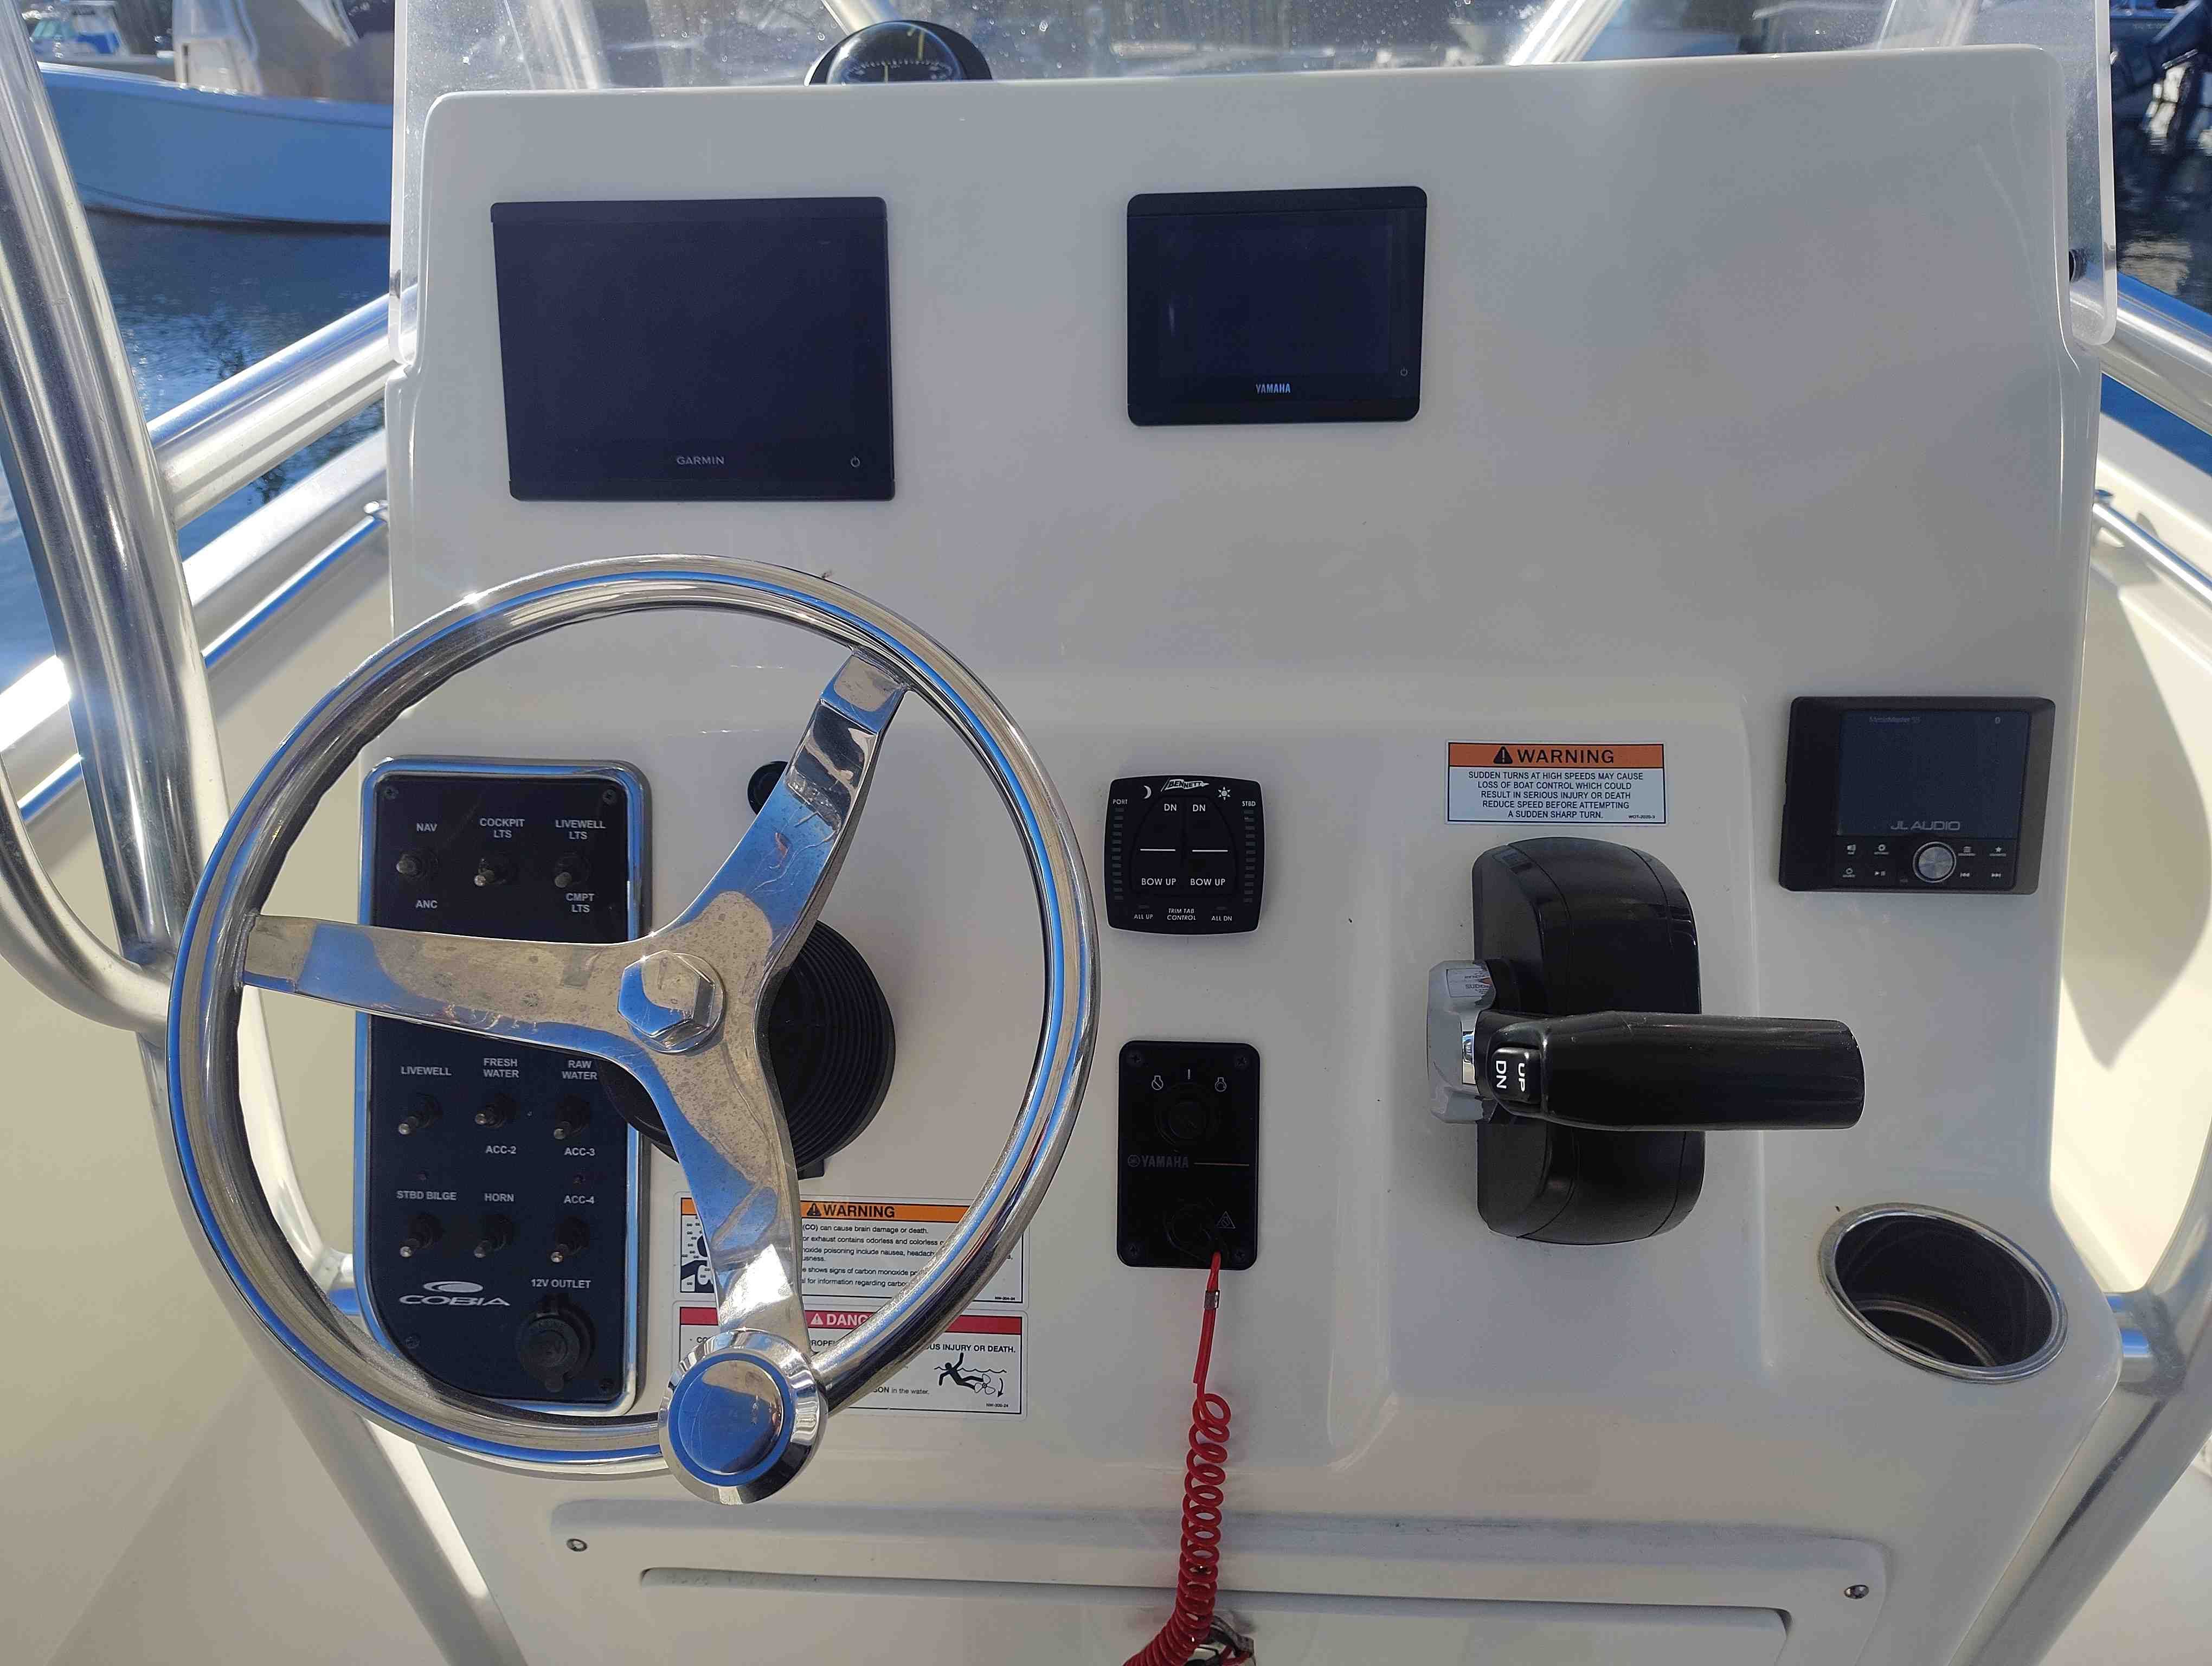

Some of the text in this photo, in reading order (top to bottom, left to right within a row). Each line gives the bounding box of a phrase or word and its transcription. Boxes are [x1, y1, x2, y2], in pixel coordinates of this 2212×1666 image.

[1256, 383, 1291, 394] YAMAHA
[677, 456, 725, 465] GARMIN
[1517, 749, 1615, 764] WARNING
[1168, 780, 1203, 789] BENNETT
[416, 823, 438, 832] NAV
[479, 818, 525, 828] COCKPIT
[555, 819, 606, 829] LIVEWELL
[1891, 821, 1960, 831] JL AUDIO
[493, 829, 512, 838] LTS
[569, 831, 587, 840] LTS
[566, 893, 594, 902] CMPT
[416, 900, 438, 909] ANC
[572, 904, 590, 913] LTS
[484, 1058, 518, 1067] FRESH
[568, 1060, 591, 1069] RAW
[401, 1066, 452, 1076] LIVEWELL
[484, 1069, 519, 1078] WATER
[562, 1071, 597, 1080] WATER
[1496, 1060, 1507, 1090] DN
[1518, 1062, 1526, 1092] UP
[485, 1145, 517, 1155] ACC-2
[564, 1147, 595, 1157] ACC-3
[1141, 1155, 1188, 1168] YAMAHA
[397, 1190, 457, 1201] STBD BILGE
[484, 1193, 514, 1202] HORN
[564, 1195, 595, 1204] ACC-4
[823, 1204, 895, 1218] WARNING
[531, 1278, 591, 1290] 12V OUTLET
[399, 1295, 511, 1306] COBIA
